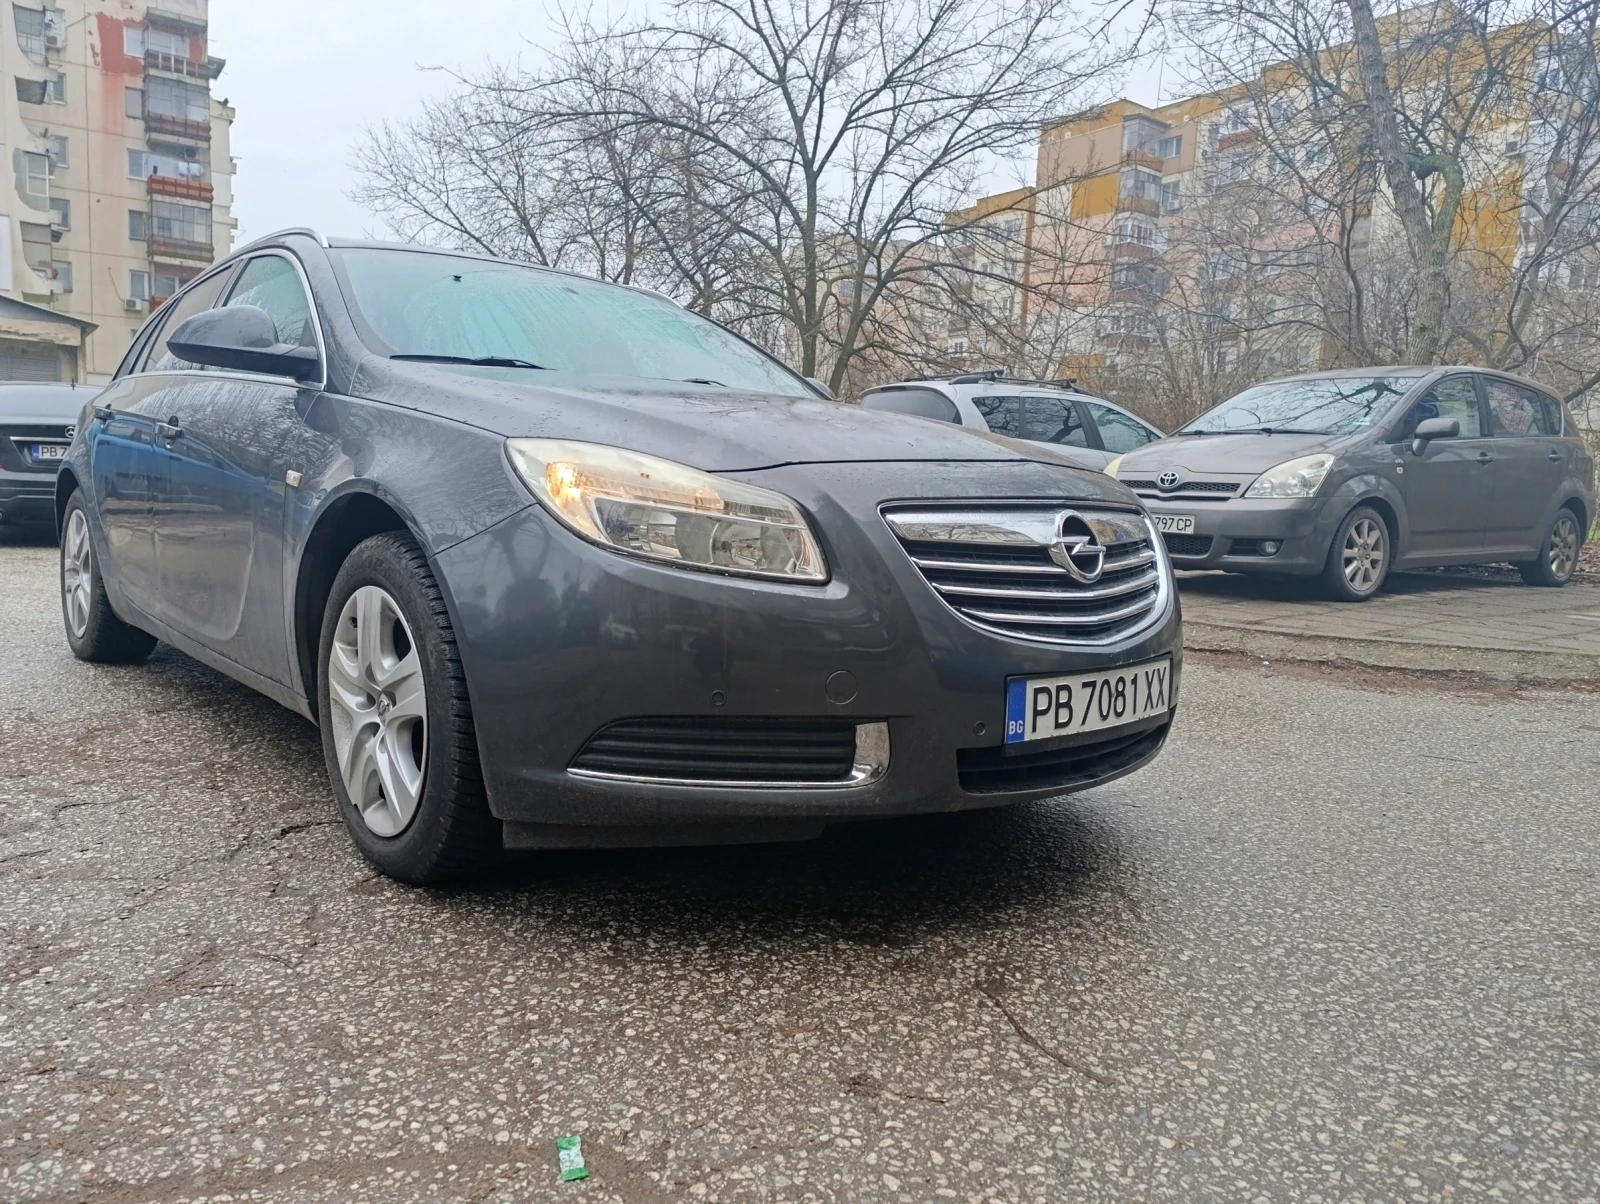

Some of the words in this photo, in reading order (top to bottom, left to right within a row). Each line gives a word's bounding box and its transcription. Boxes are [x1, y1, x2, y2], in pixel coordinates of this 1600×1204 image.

[41, 446, 58, 457] PB
[1176, 518, 1192, 531] CP
[1031, 683, 1073, 733] PB
[1080, 673, 1138, 726] 7081
[1143, 666, 1167, 713] XX
[1008, 720, 1024, 735] BG
